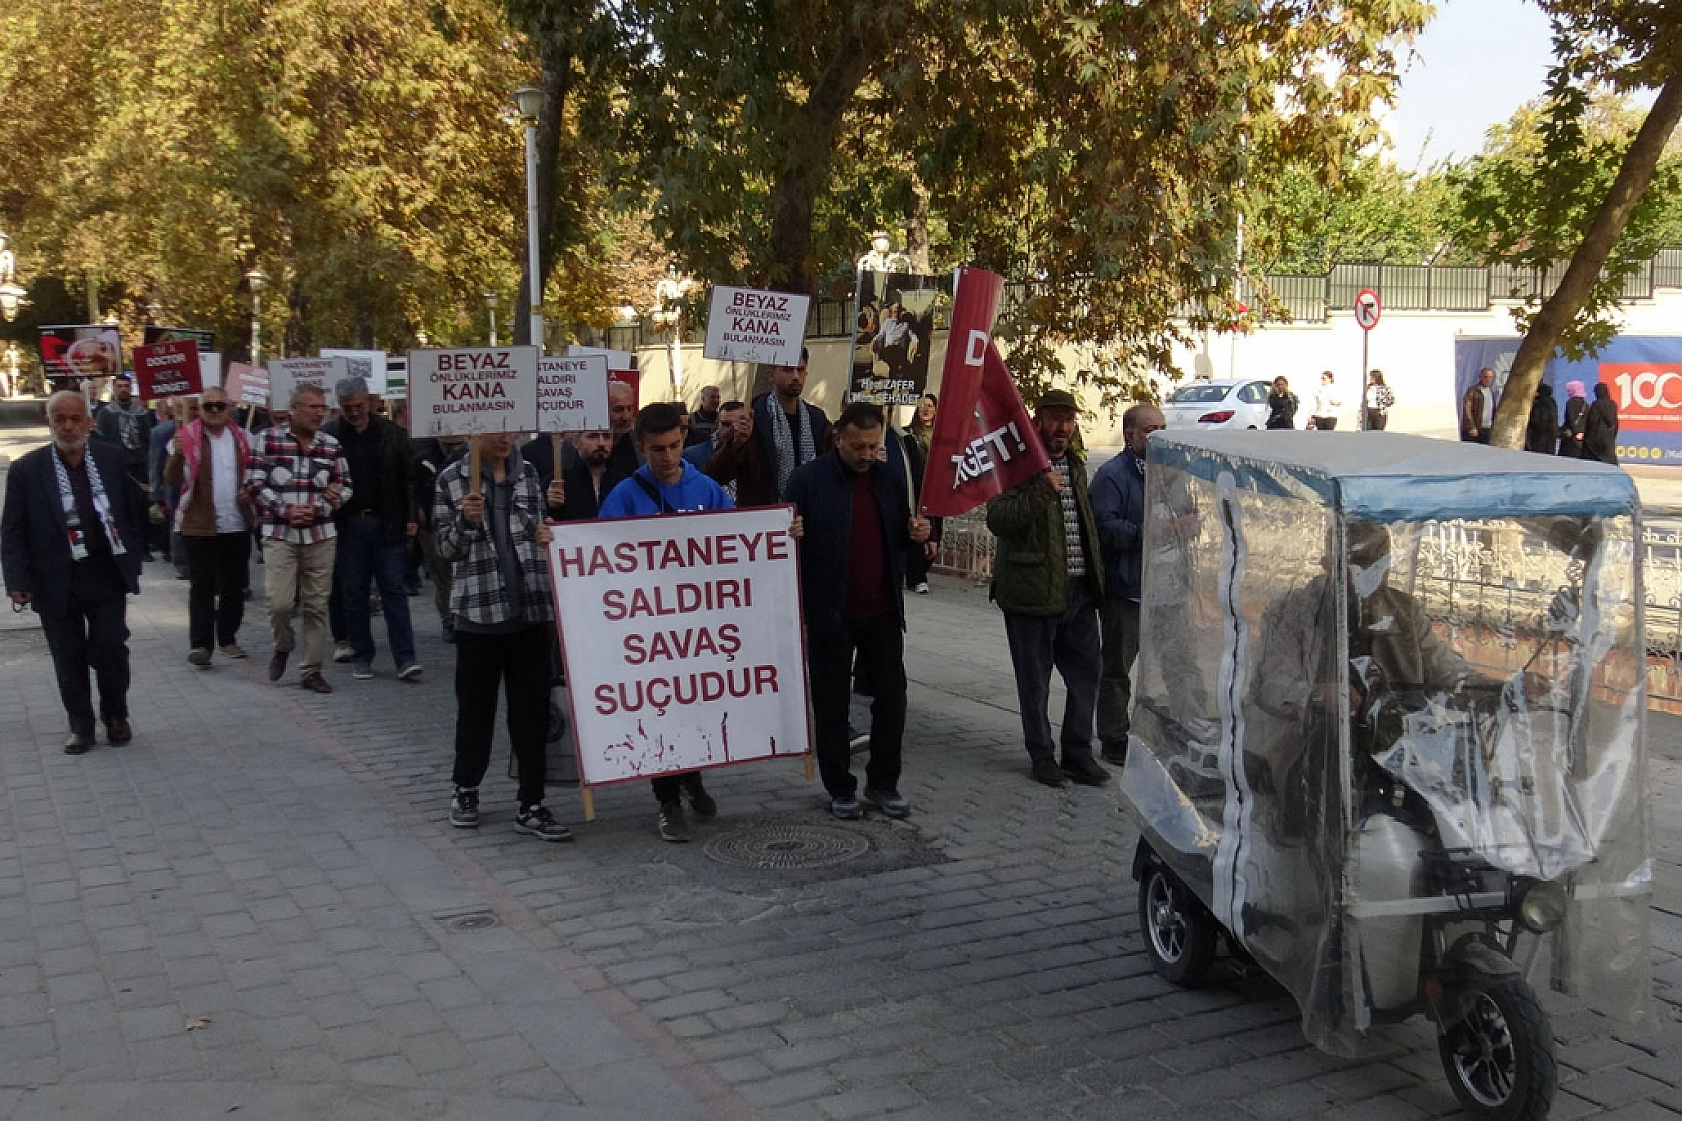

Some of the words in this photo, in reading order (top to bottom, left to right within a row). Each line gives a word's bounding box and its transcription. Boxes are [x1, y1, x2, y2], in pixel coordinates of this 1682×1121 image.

[733, 292, 789, 311] BEYAZ
[731, 317, 781, 336] KANA
[723, 332, 786, 347] BULANMASIN
[146, 353, 186, 367] DOCTOR
[438, 352, 511, 371] BEYAZ
[538, 373, 577, 384] ALDIRI
[883, 379, 915, 390] ZAFER
[442, 381, 506, 401] KANA
[432, 400, 515, 414] BULANMASIN
[538, 400, 585, 413] ÇUDUR
[558, 530, 789, 578] HASTANEYE
[602, 578, 752, 621] SALDIRI
[623, 623, 741, 665] SAVAŞ
[594, 665, 779, 717] SUÇUDUR
